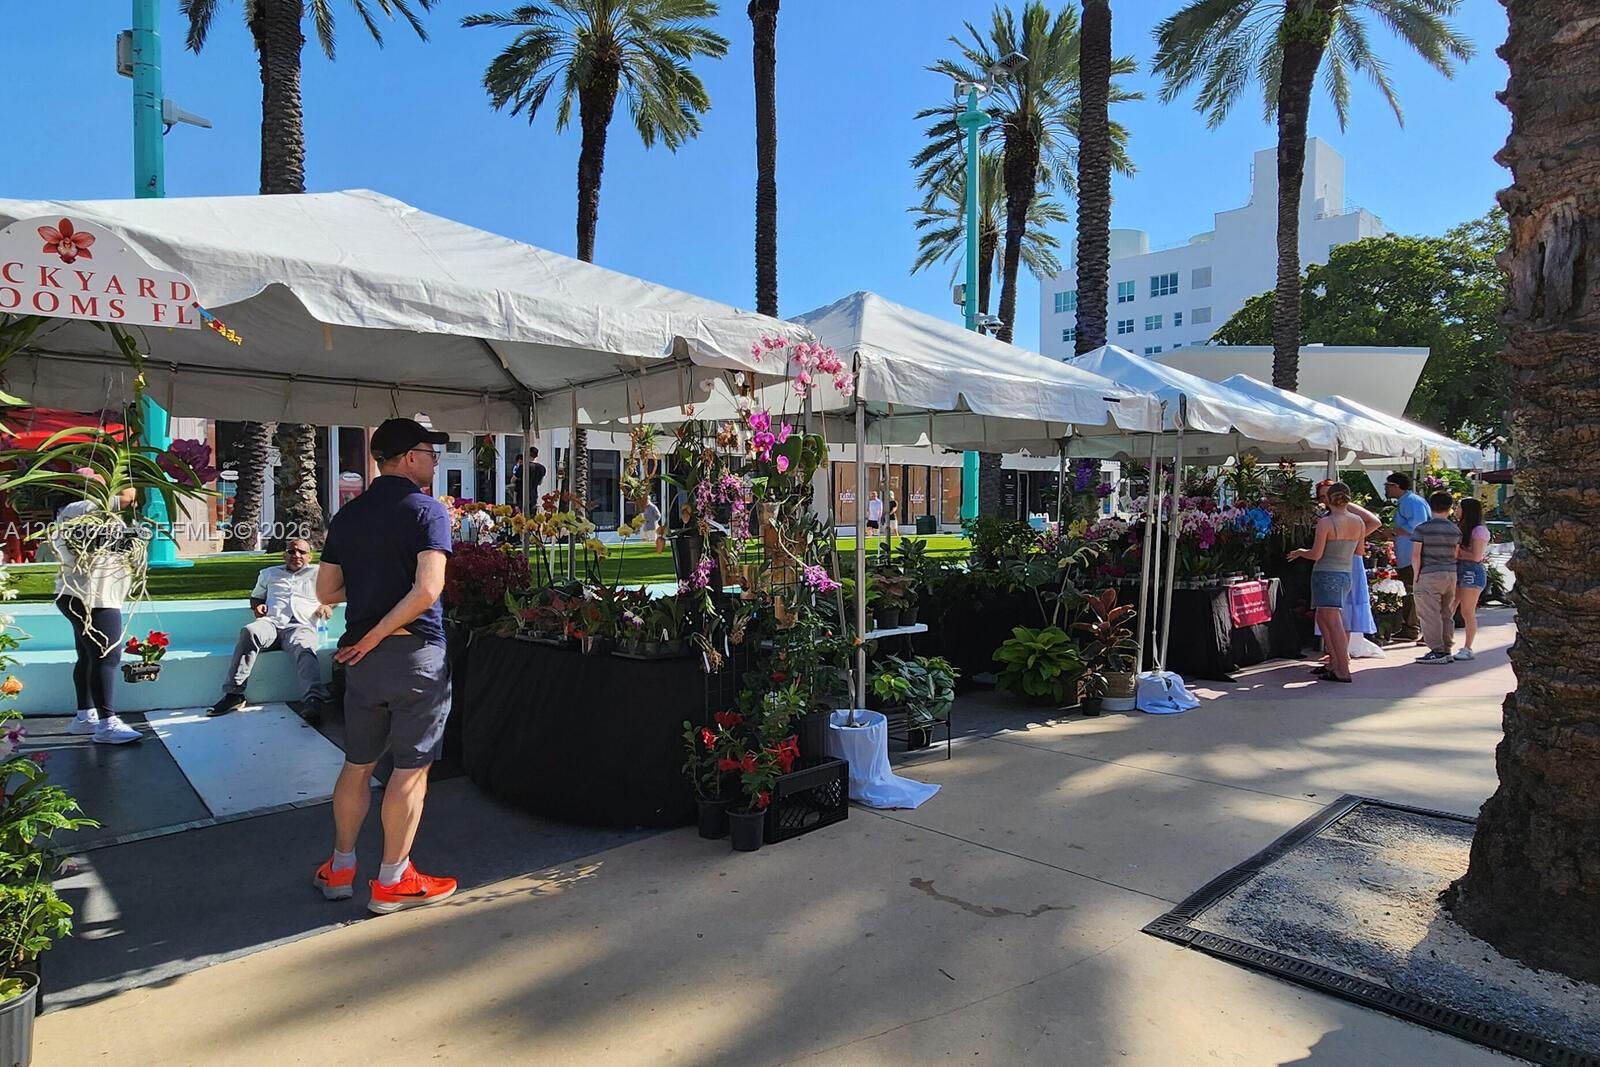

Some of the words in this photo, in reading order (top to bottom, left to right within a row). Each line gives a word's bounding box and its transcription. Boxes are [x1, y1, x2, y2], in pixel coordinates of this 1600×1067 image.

[2, 262, 191, 301] CKYARD
[0, 286, 125, 319] OOMS
[152, 303, 193, 325] FL
